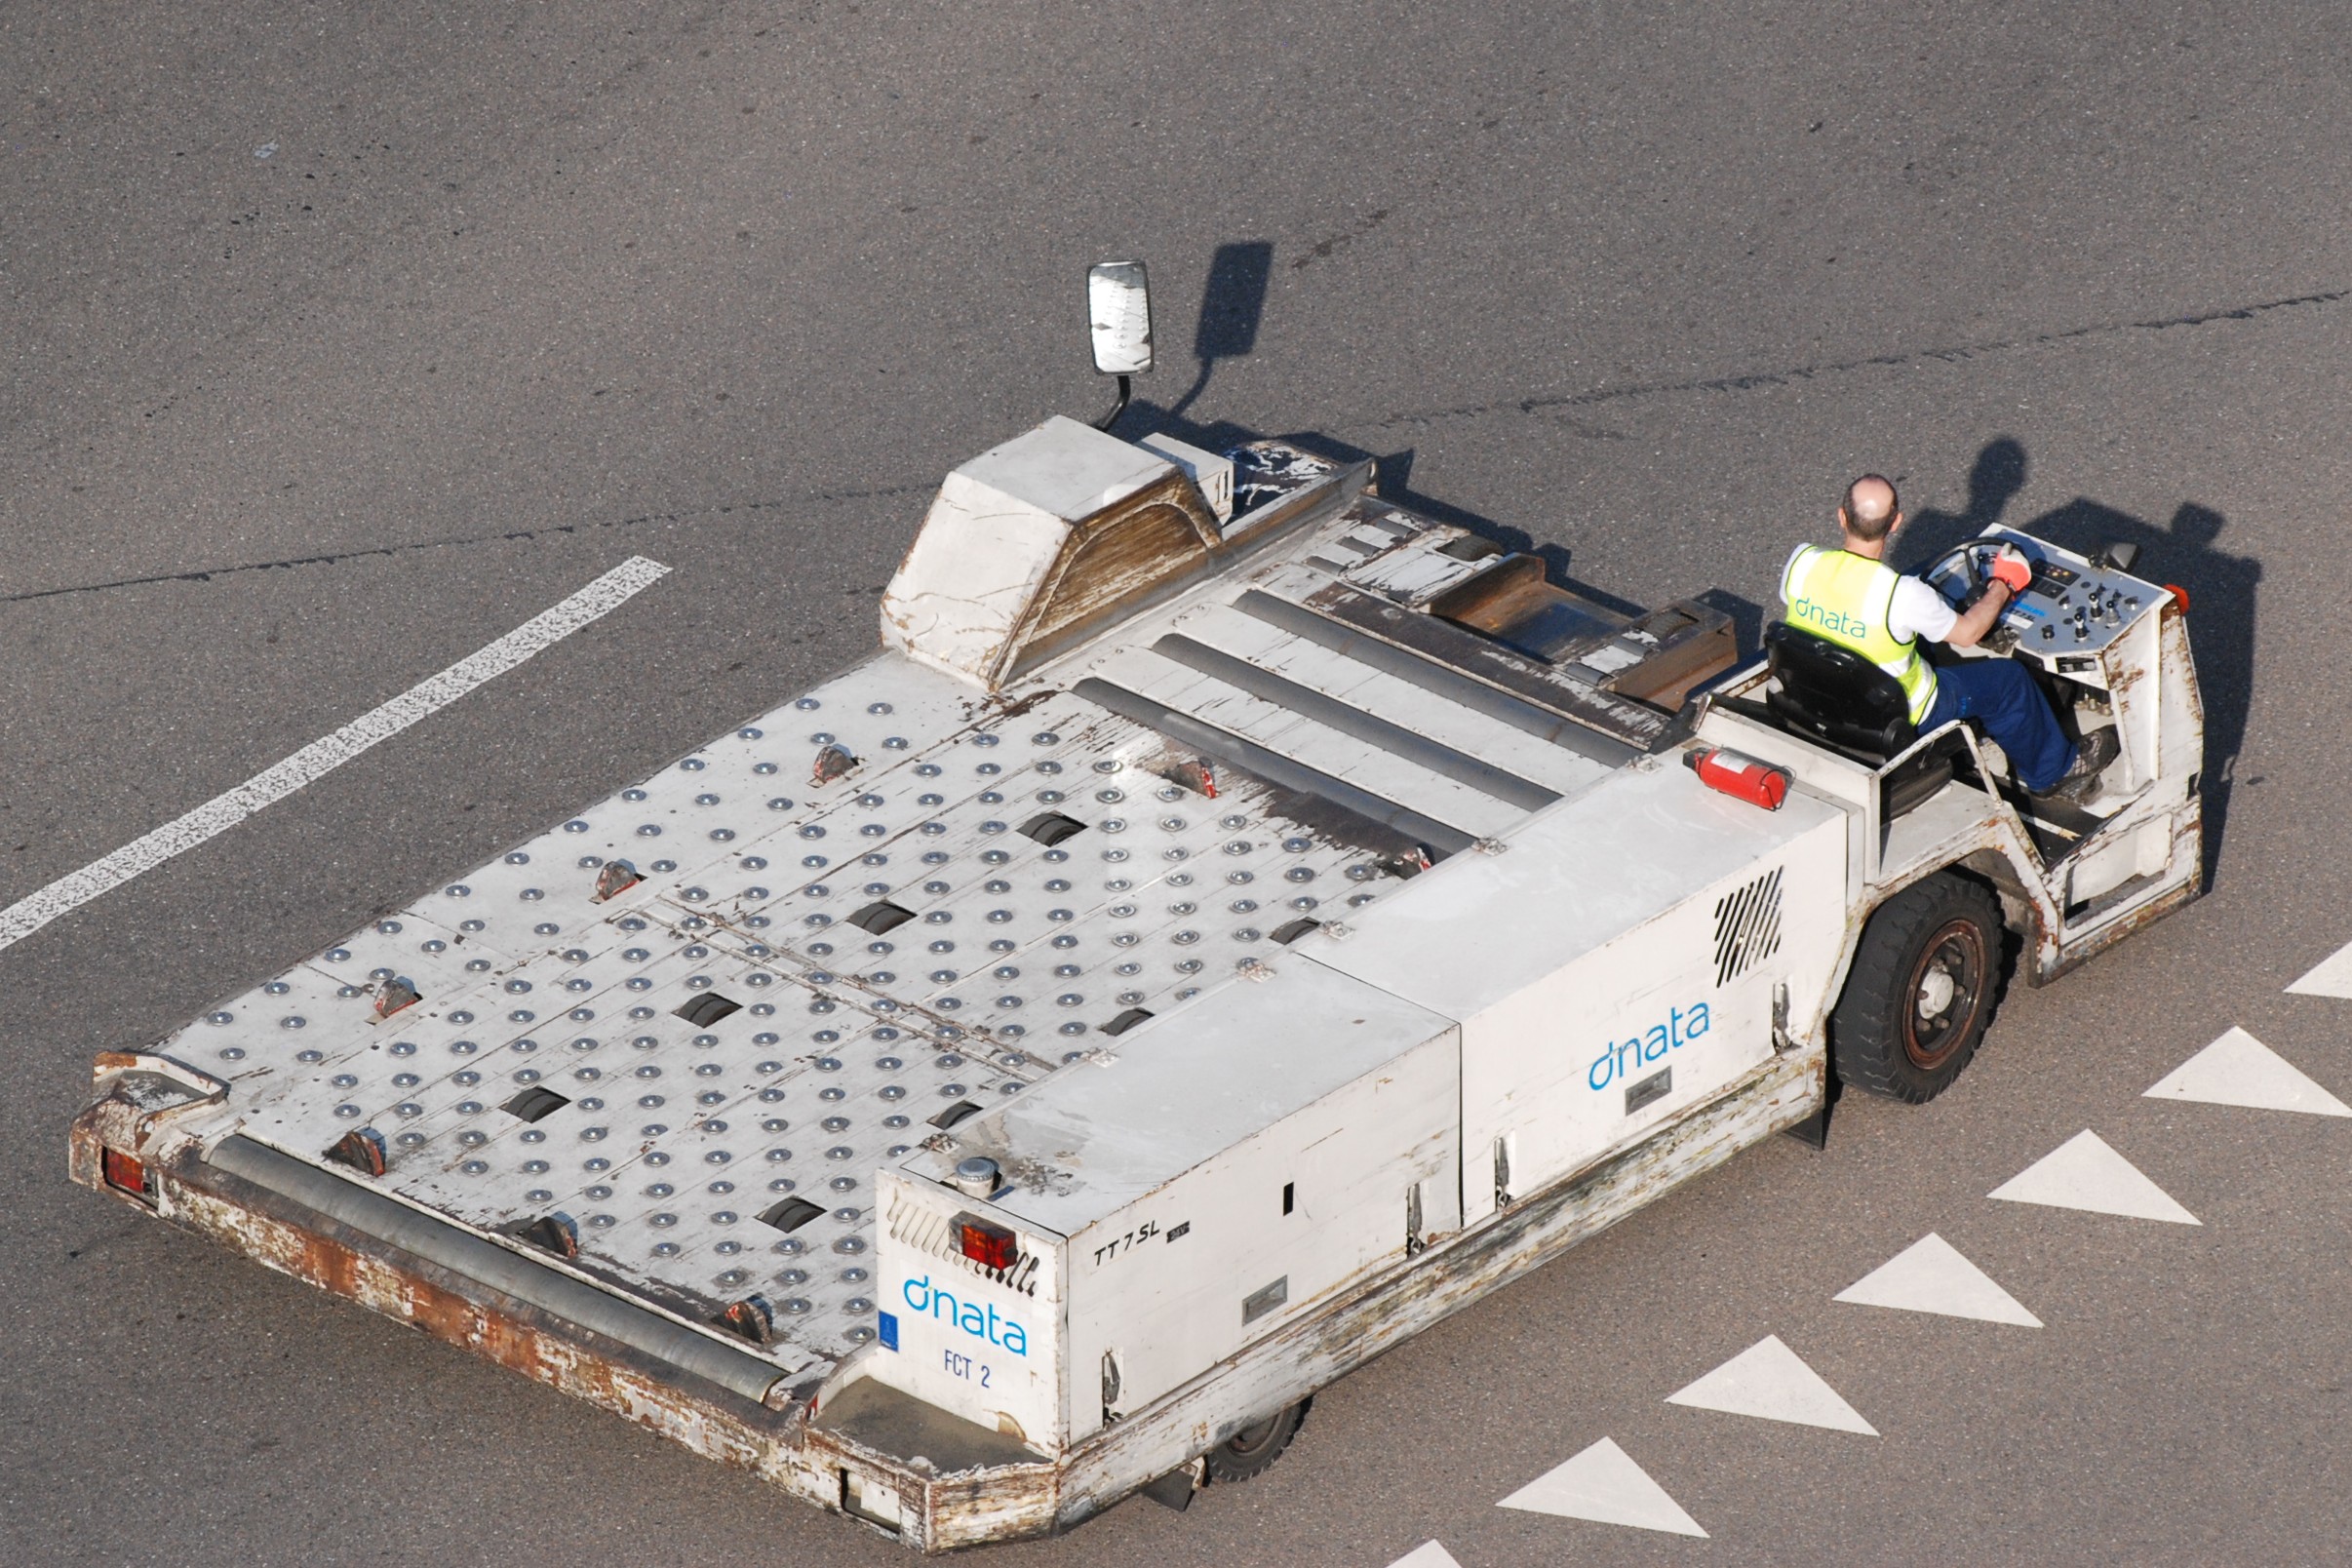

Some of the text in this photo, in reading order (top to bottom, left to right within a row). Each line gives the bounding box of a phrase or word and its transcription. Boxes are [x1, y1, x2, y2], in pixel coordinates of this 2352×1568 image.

[1795, 597, 1866, 639] dnata
[1588, 1002, 1709, 1091] dnata
[903, 1274, 1027, 1357] dnata
[944, 1349, 991, 1389] FCT 2
